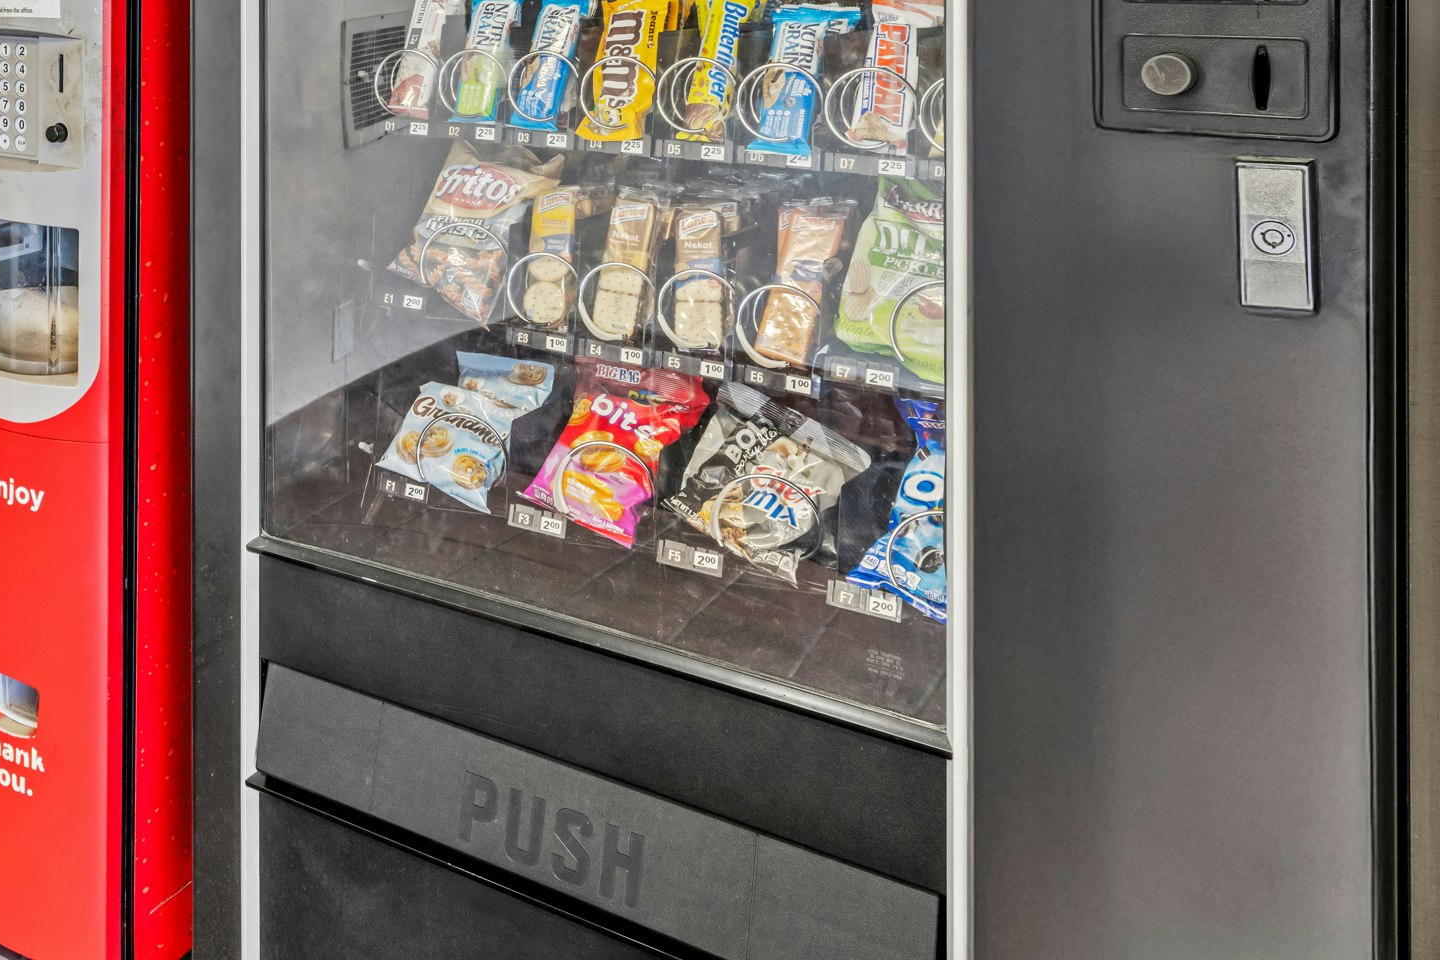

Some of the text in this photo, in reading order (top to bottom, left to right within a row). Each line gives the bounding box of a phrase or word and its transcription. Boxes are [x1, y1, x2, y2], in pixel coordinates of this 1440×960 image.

[3, 45, 8, 54] 1
[19, 46, 25, 56] 2
[708, 0, 748, 103] Butterfinger
[2, 63, 9, 73] 3
[19, 64, 25, 74] 4
[872, 22, 911, 127] PAYDAY
[3, 82, 9, 91] 5
[19, 83, 25, 93] 6
[3, 100, 9, 109] 7
[19, 102, 25, 111] 8
[3, 118, 8, 128] 9
[19, 120, 25, 129] 0
[384, 122, 395, 132] D1
[517, 132, 530, 143] D3
[667, 144, 681, 155] D5
[840, 158, 856, 170] D7
[517, 332, 529, 343] E3
[590, 344, 602, 356] E4
[750, 371, 764, 383] E6
[836, 366, 850, 378] E7
[590, 393, 656, 440] bits
[386, 481, 396, 491] F1
[519, 513, 530, 525] F3
[668, 549, 681, 562] F5
[840, 591, 854, 604] F7
[458, 770, 647, 910] PUSH
